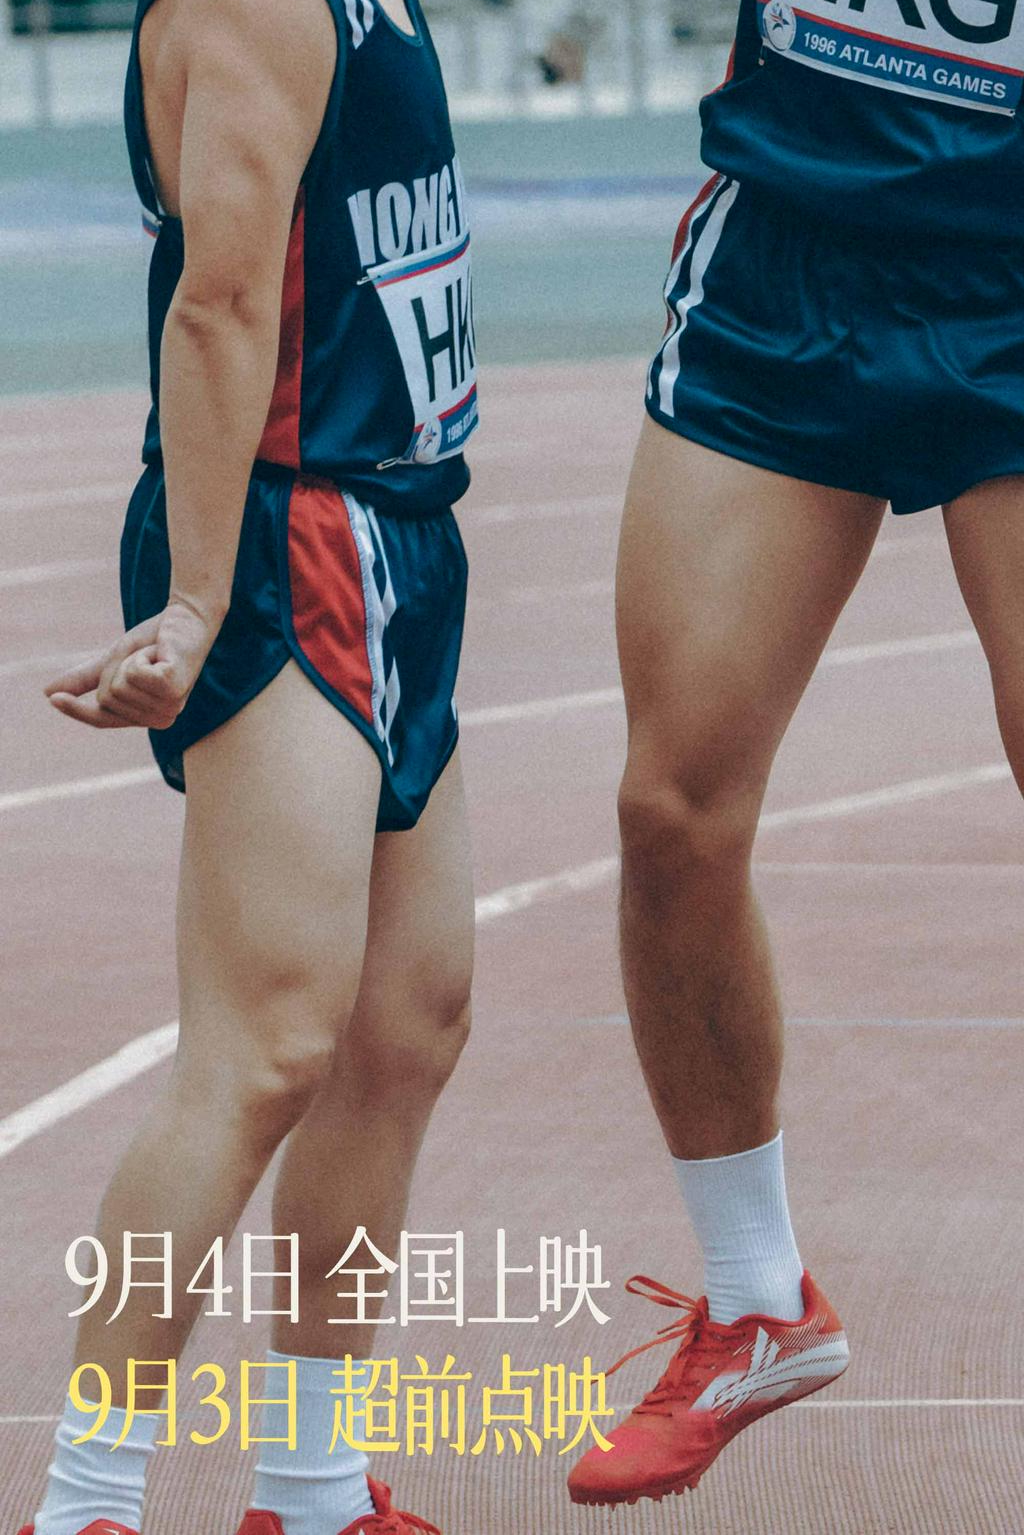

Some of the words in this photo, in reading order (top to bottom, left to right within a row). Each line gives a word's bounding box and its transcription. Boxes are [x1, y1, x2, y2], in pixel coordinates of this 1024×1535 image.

[803, 31, 836, 57] 1996
[839, 44, 927, 81] ATLANTA
[932, 68, 1007, 99] GAMES
[410, 264, 477, 403] HK
